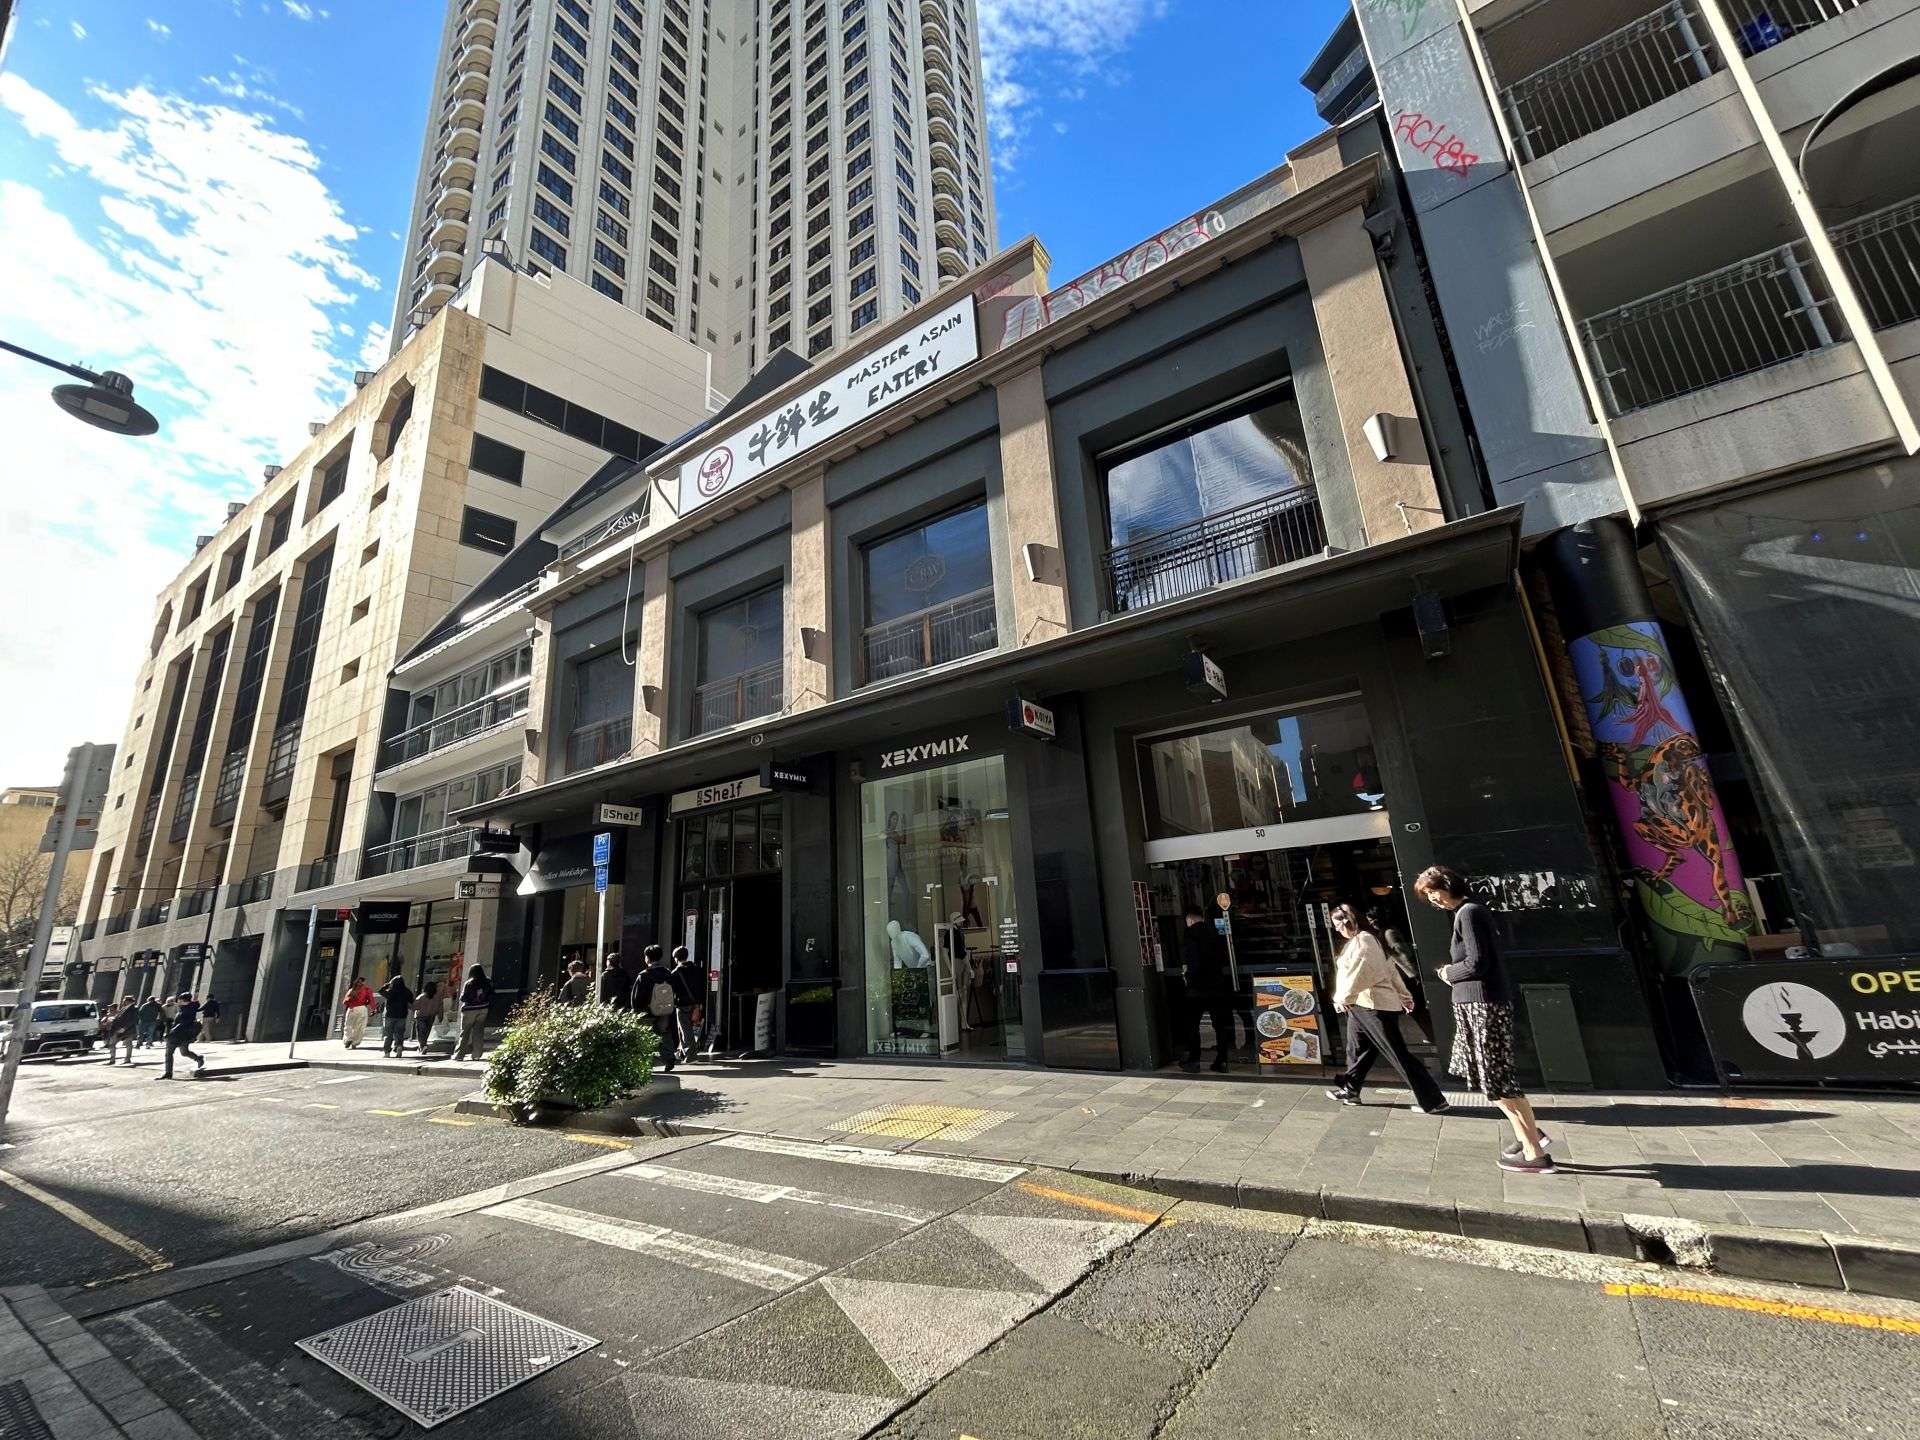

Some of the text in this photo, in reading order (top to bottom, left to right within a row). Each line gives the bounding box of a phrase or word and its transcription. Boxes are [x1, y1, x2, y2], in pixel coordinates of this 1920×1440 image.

[847, 313, 962, 390] MASTER ASAIN
[867, 350, 942, 408] EATERY
[881, 734, 970, 769] XEXYMIX
[774, 771, 807, 783] XEXYMIX
[703, 781, 743, 804] Shelf
[608, 809, 640, 821] Shelf
[1255, 828, 1265, 838] 50
[461, 884, 475, 895] 48
